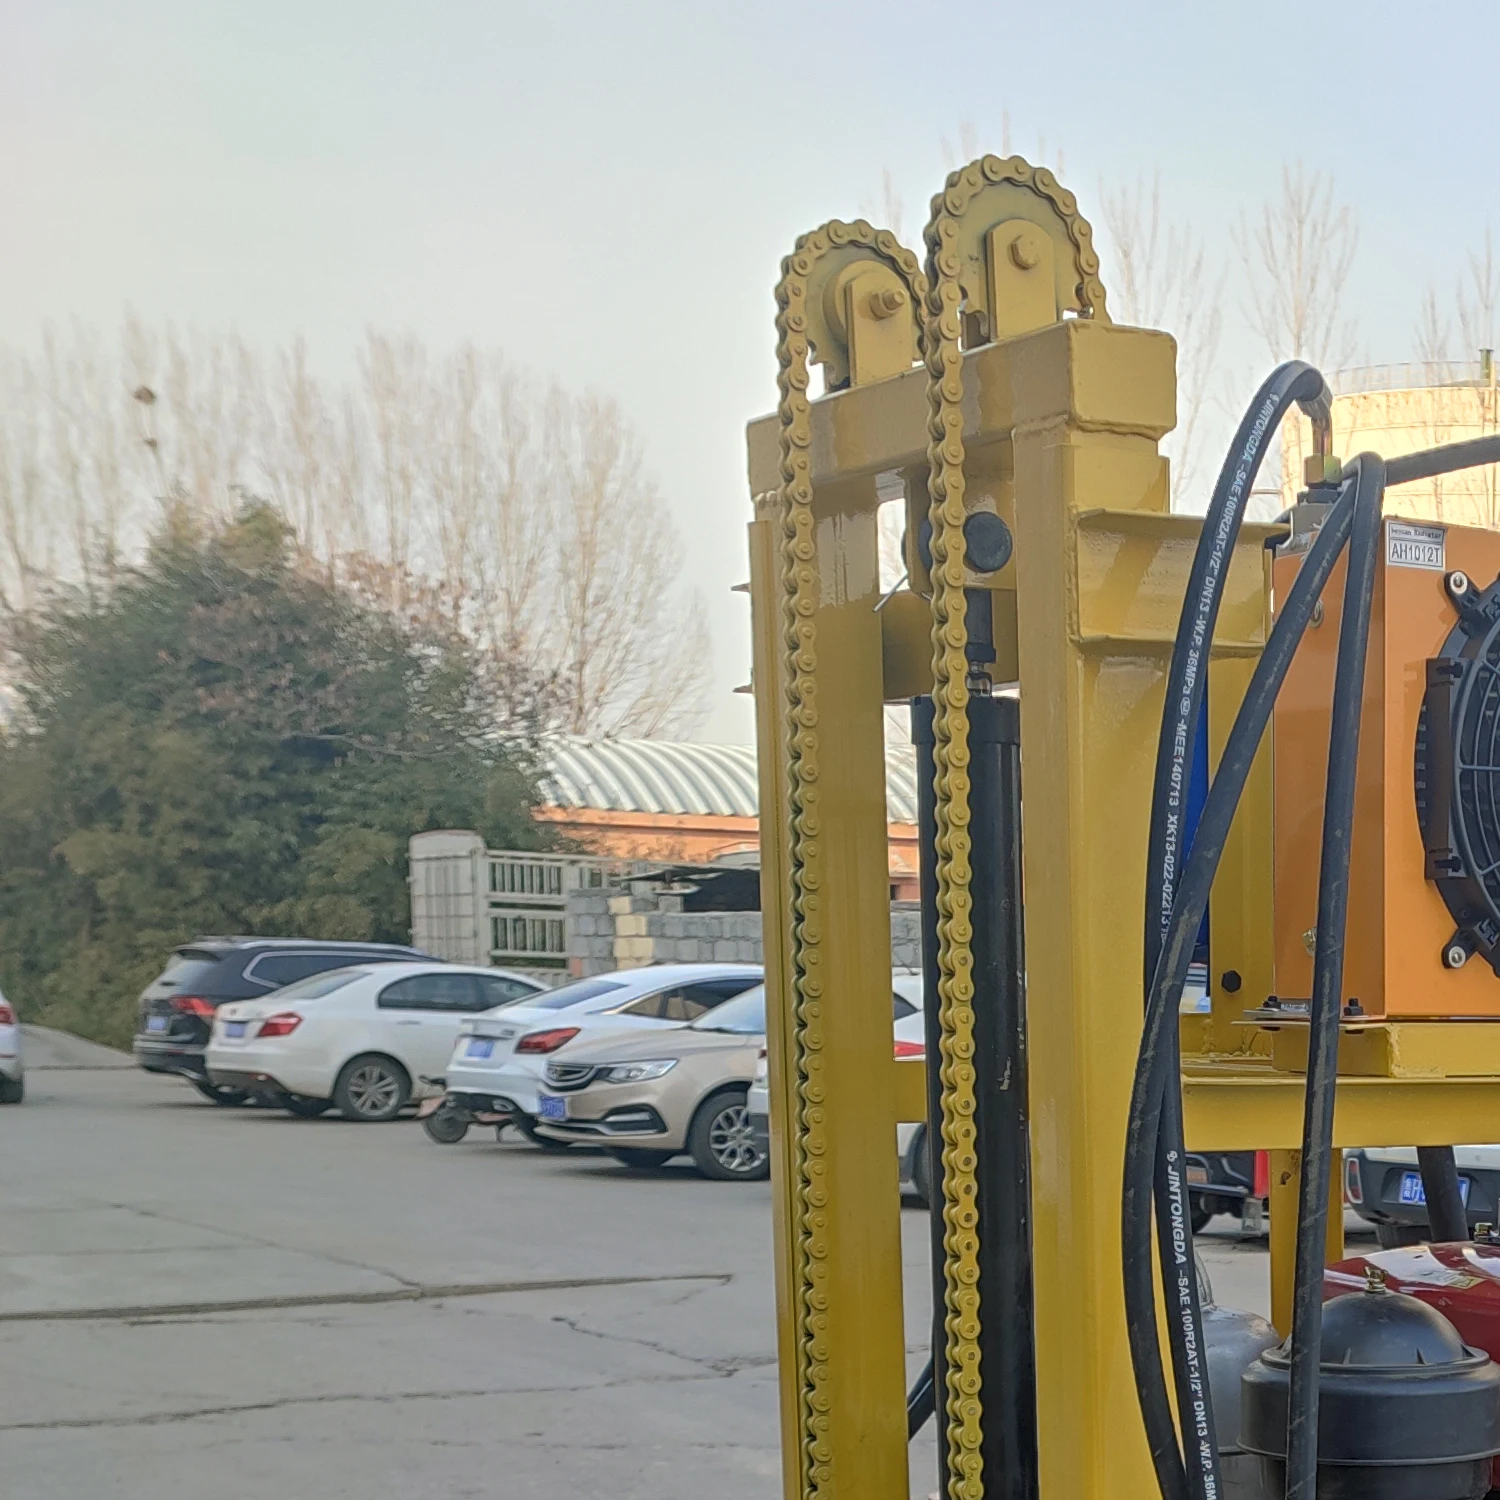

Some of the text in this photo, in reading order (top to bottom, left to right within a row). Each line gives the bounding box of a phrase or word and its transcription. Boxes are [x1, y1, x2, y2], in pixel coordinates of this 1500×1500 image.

[1391, 543, 1441, 563] AH1012T
[1167, 1164, 1188, 1265] JINTONGDA
[1193, 1400, 1208, 1437] DN13
